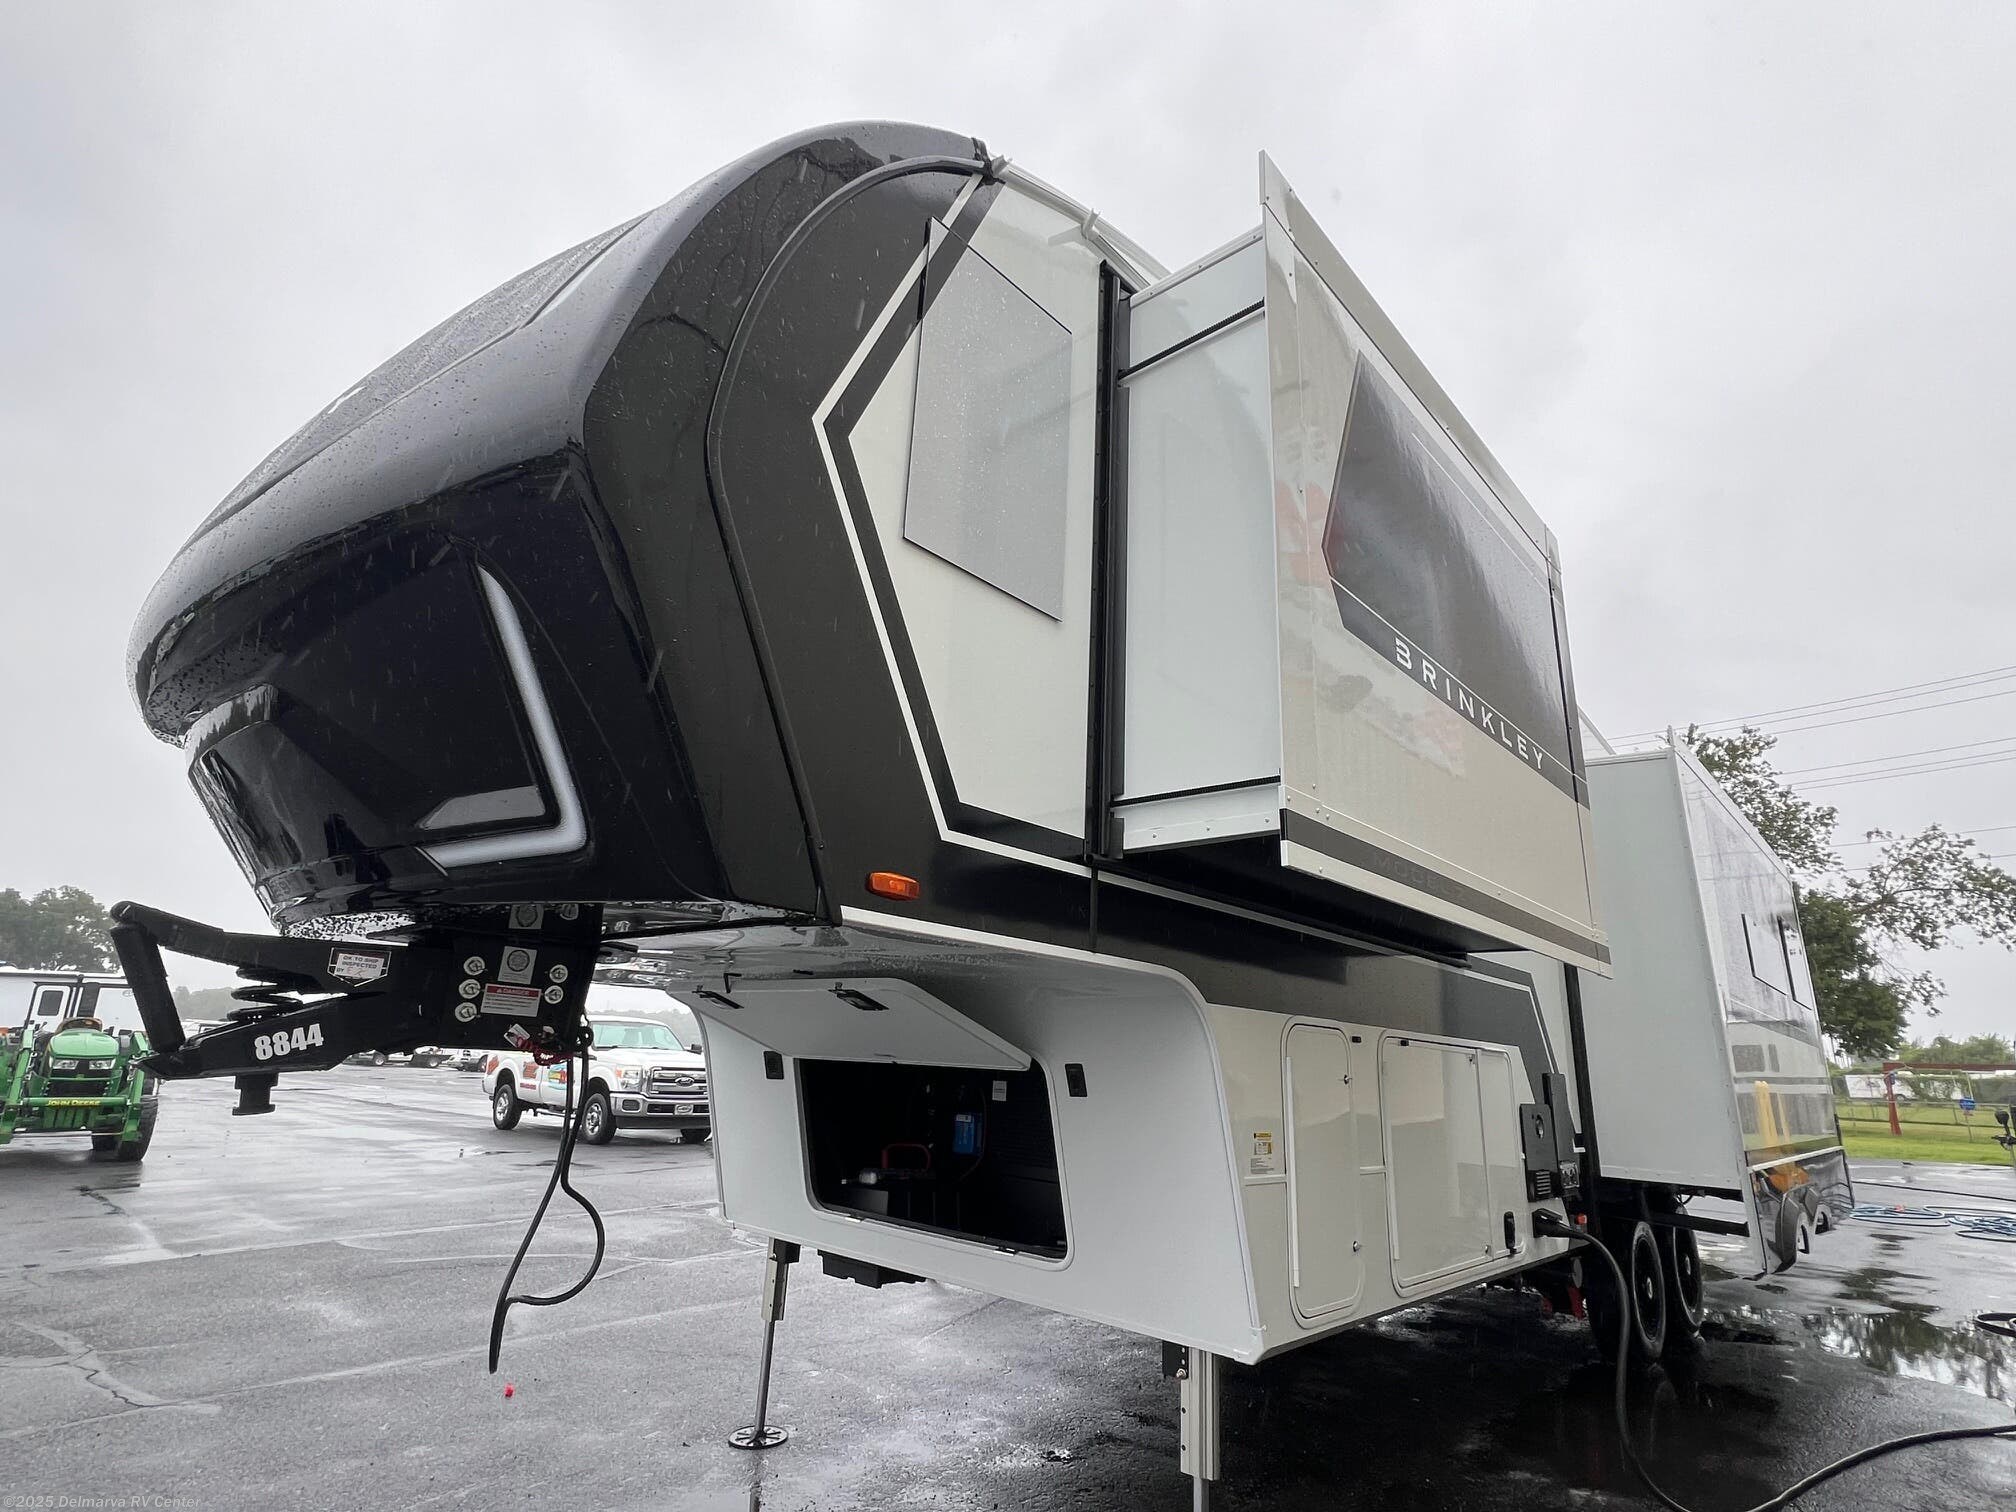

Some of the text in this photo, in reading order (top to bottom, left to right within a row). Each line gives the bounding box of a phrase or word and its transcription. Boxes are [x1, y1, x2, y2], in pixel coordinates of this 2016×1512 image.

[1395, 637, 1543, 769] BRINKLEY
[342, 961, 377, 969] INSPECTED
[254, 1023, 324, 1060] 8844
